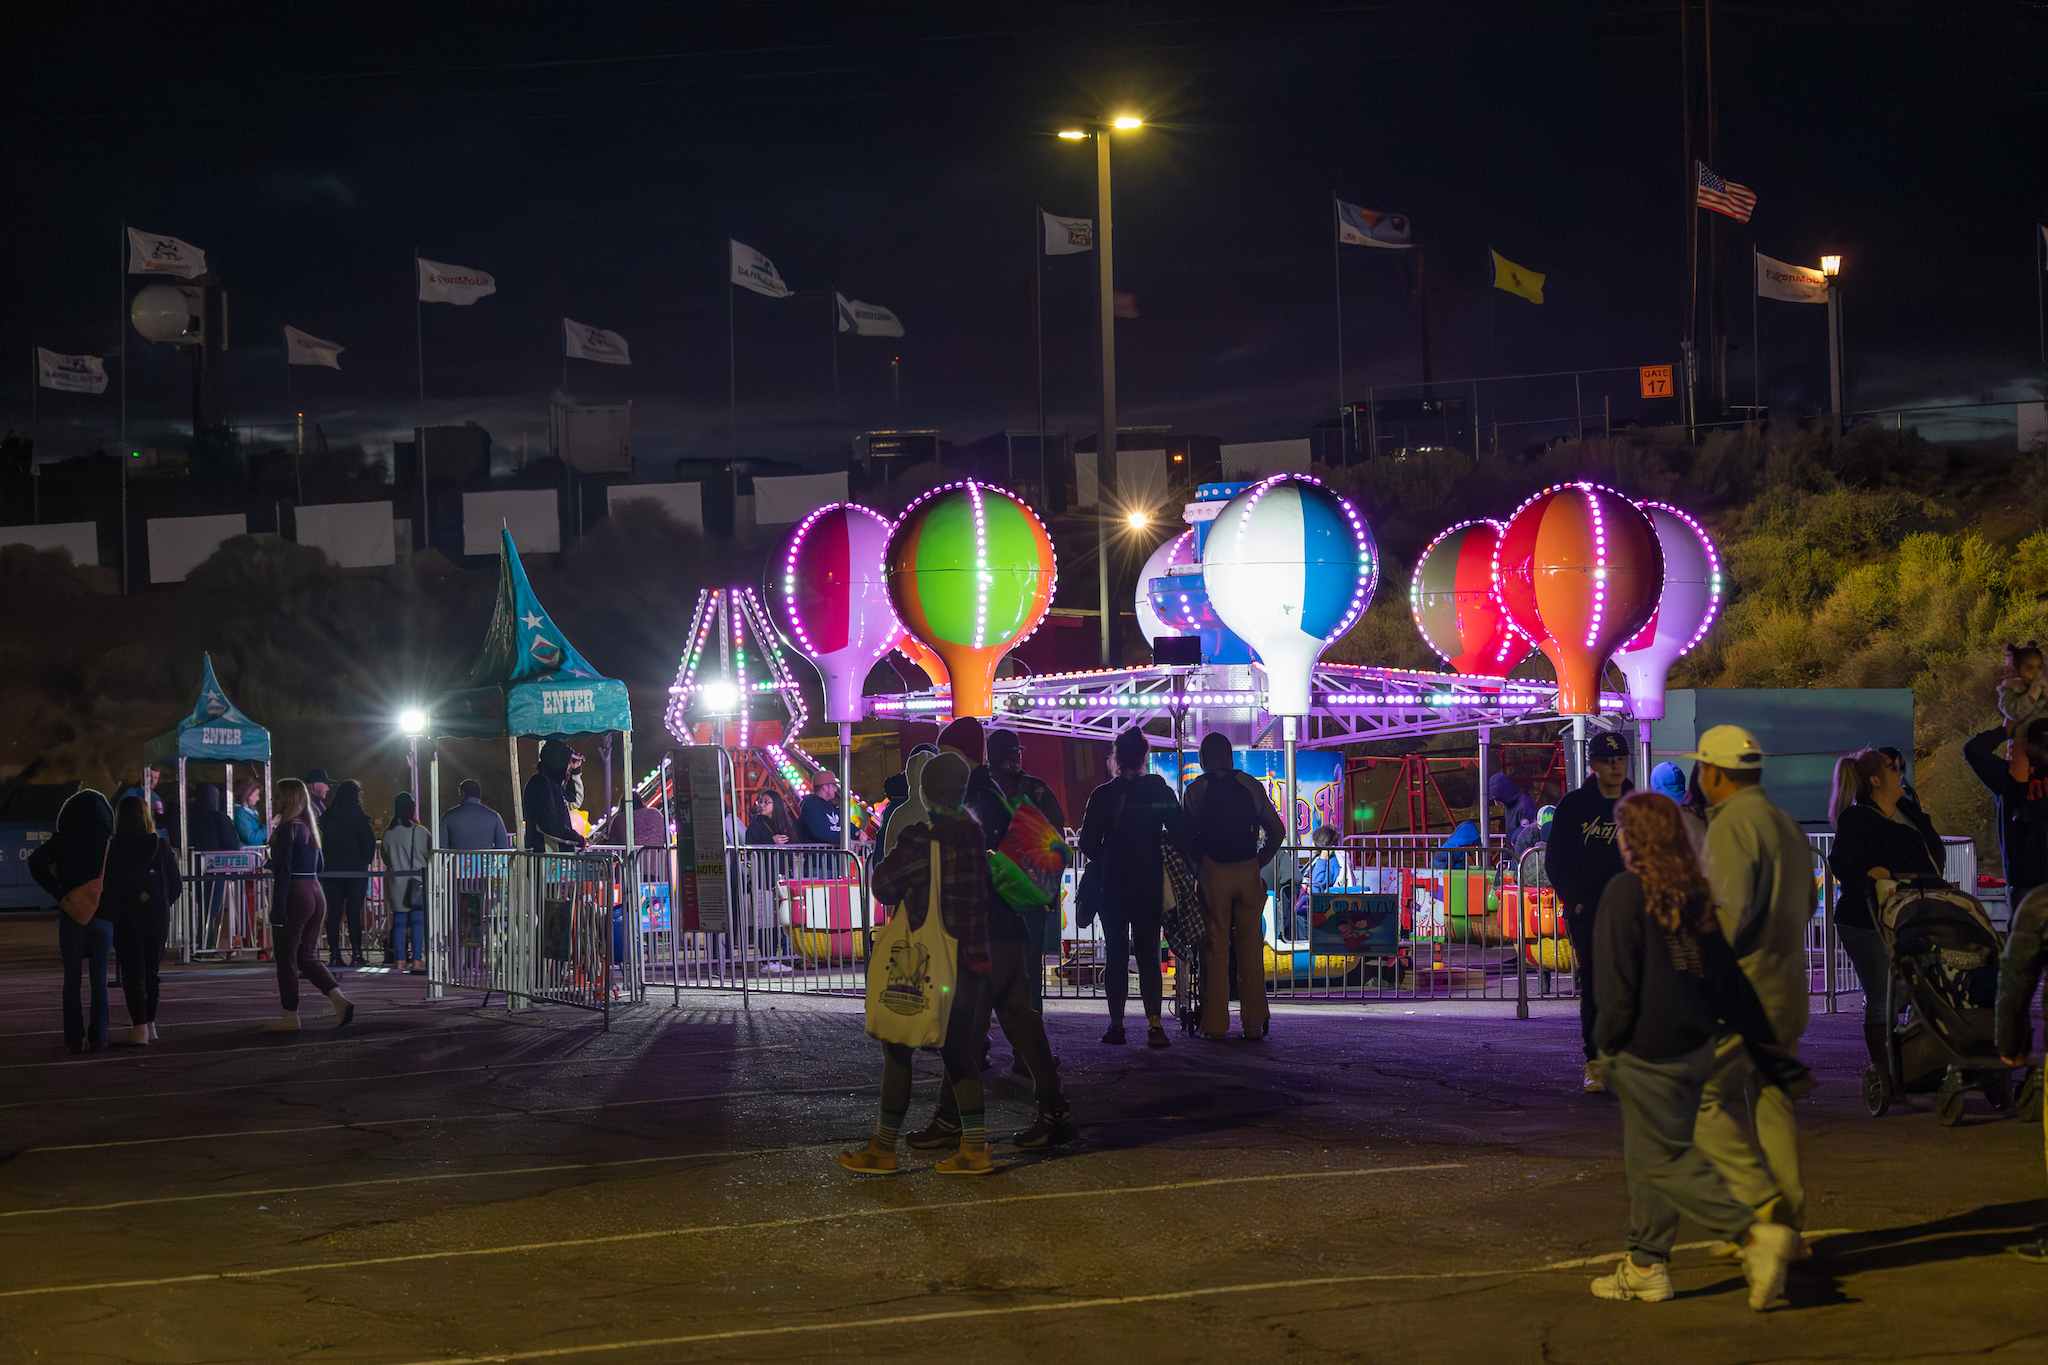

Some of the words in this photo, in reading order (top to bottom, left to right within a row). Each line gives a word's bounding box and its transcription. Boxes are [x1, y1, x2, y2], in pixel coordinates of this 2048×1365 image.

[1644, 369, 1669, 378] GATE
[1648, 380, 1666, 393] 17
[541, 689, 596, 714] ENTER
[202, 727, 242, 745] ENTER
[214, 855, 249, 867] ENTER
[697, 865, 724, 875] NOTICE
[1315, 899, 1331, 913] UP
[1332, 900, 1349, 913] UP
[1361, 900, 1395, 914] AWAY
